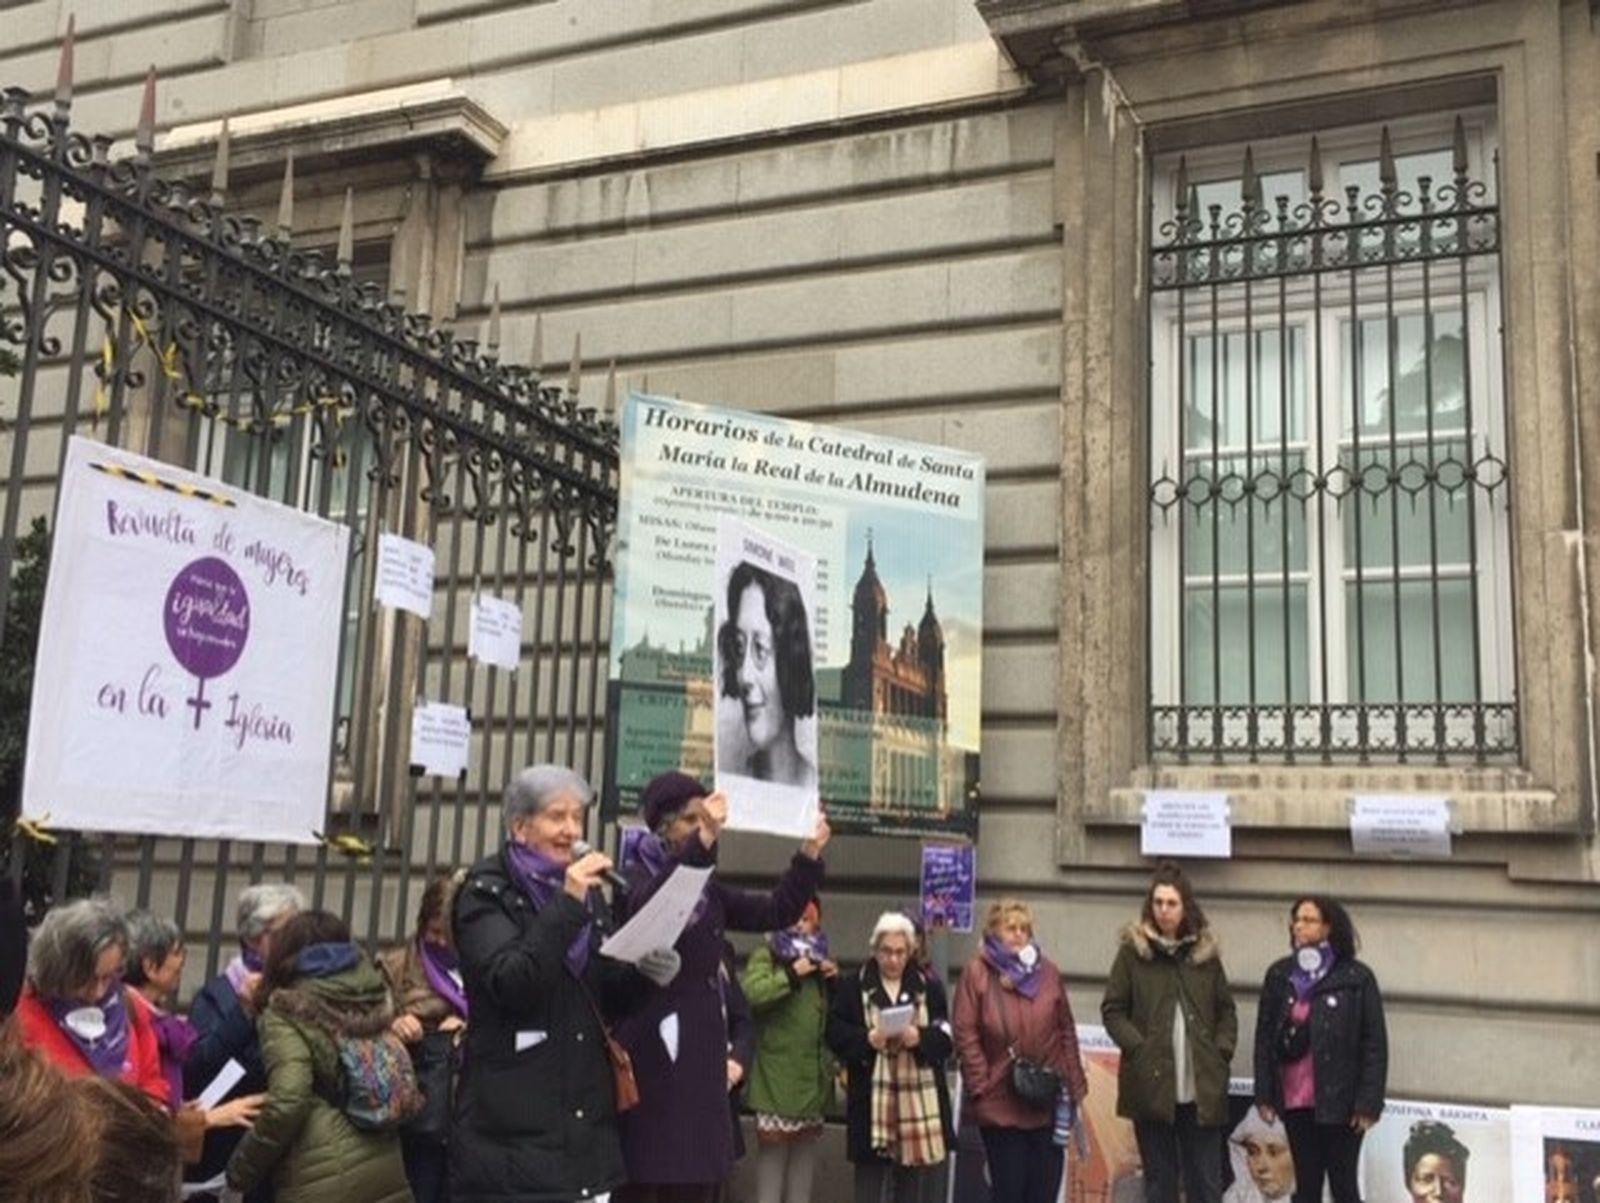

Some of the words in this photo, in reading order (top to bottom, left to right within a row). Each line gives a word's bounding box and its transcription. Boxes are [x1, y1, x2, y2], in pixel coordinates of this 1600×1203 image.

[645, 407, 759, 444] Horarios
[763, 431, 784, 447] de
[787, 433, 804, 450] la
[808, 436, 894, 466] Catedral
[897, 454, 917, 469] de
[919, 456, 975, 480] Santa
[658, 444, 727, 471] María
[731, 457, 748, 472] la
[753, 459, 802, 481] Real
[804, 469, 825, 484] de
[828, 471, 844, 488] la
[847, 472, 961, 508] Almudena
[107, 499, 195, 545] Revuelta
[213, 522, 236, 555] de
[244, 540, 310, 596] mujeres
[97, 682, 126, 714] en
[137, 662, 166, 719] la
[224, 691, 294, 751] Iglesia
